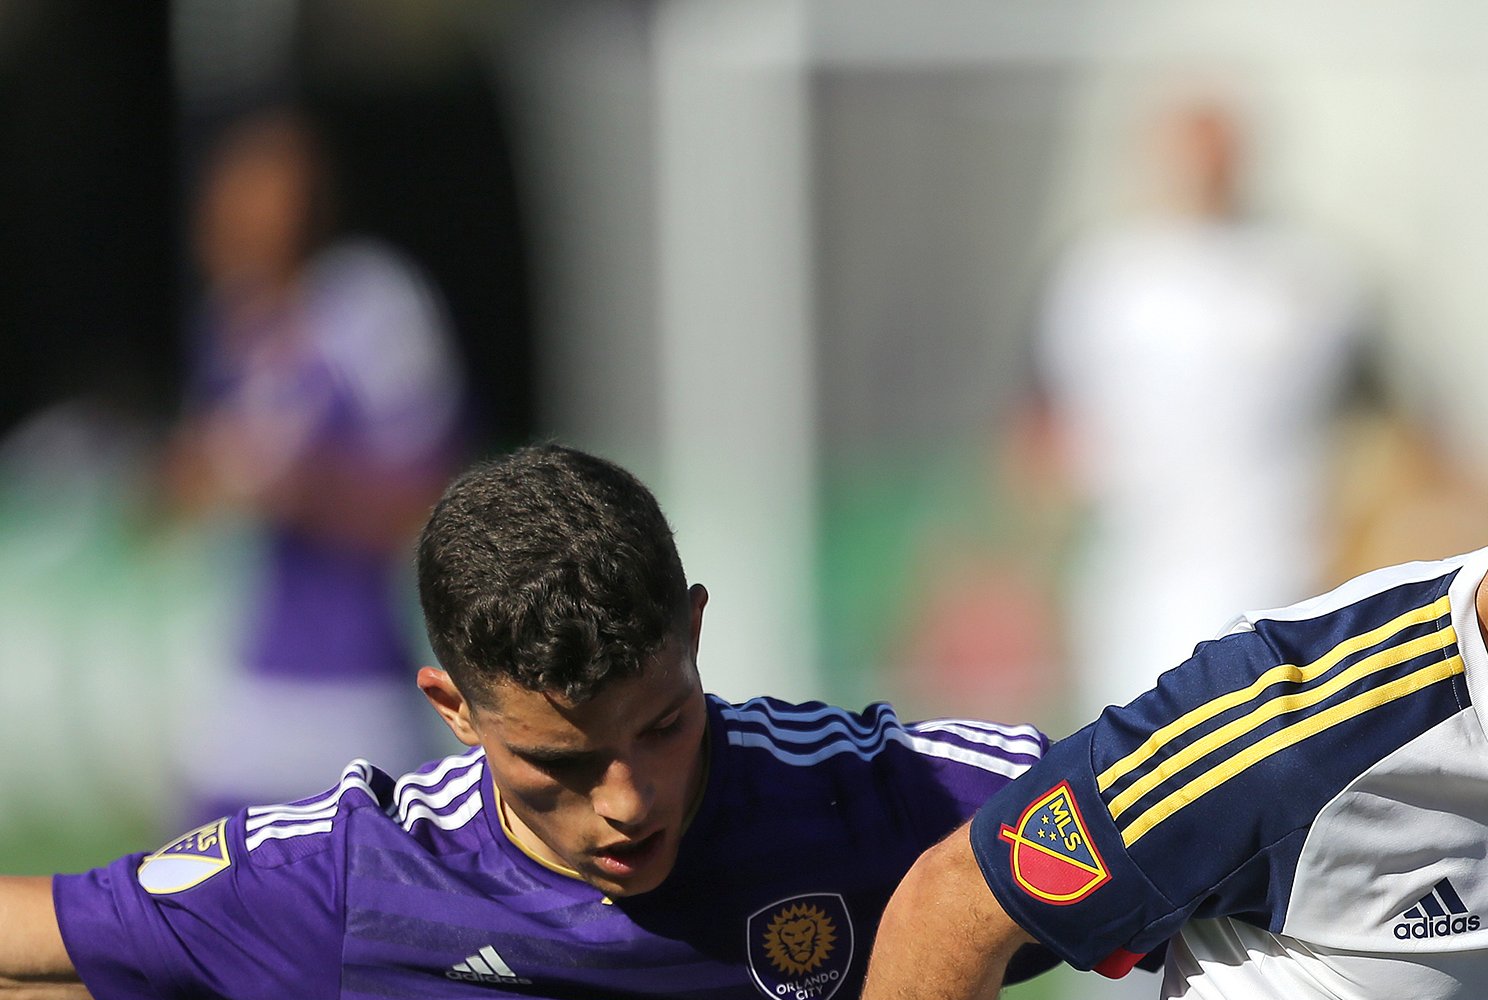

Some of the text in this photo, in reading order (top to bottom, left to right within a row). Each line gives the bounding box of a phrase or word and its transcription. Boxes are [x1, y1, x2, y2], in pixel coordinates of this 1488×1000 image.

[1048, 797, 1082, 851] MLS
[1393, 913, 1481, 940] adidas
[444, 971, 533, 985] adidas
[776, 970, 840, 995] ORLANDO
[795, 985, 824, 1000] CITY
